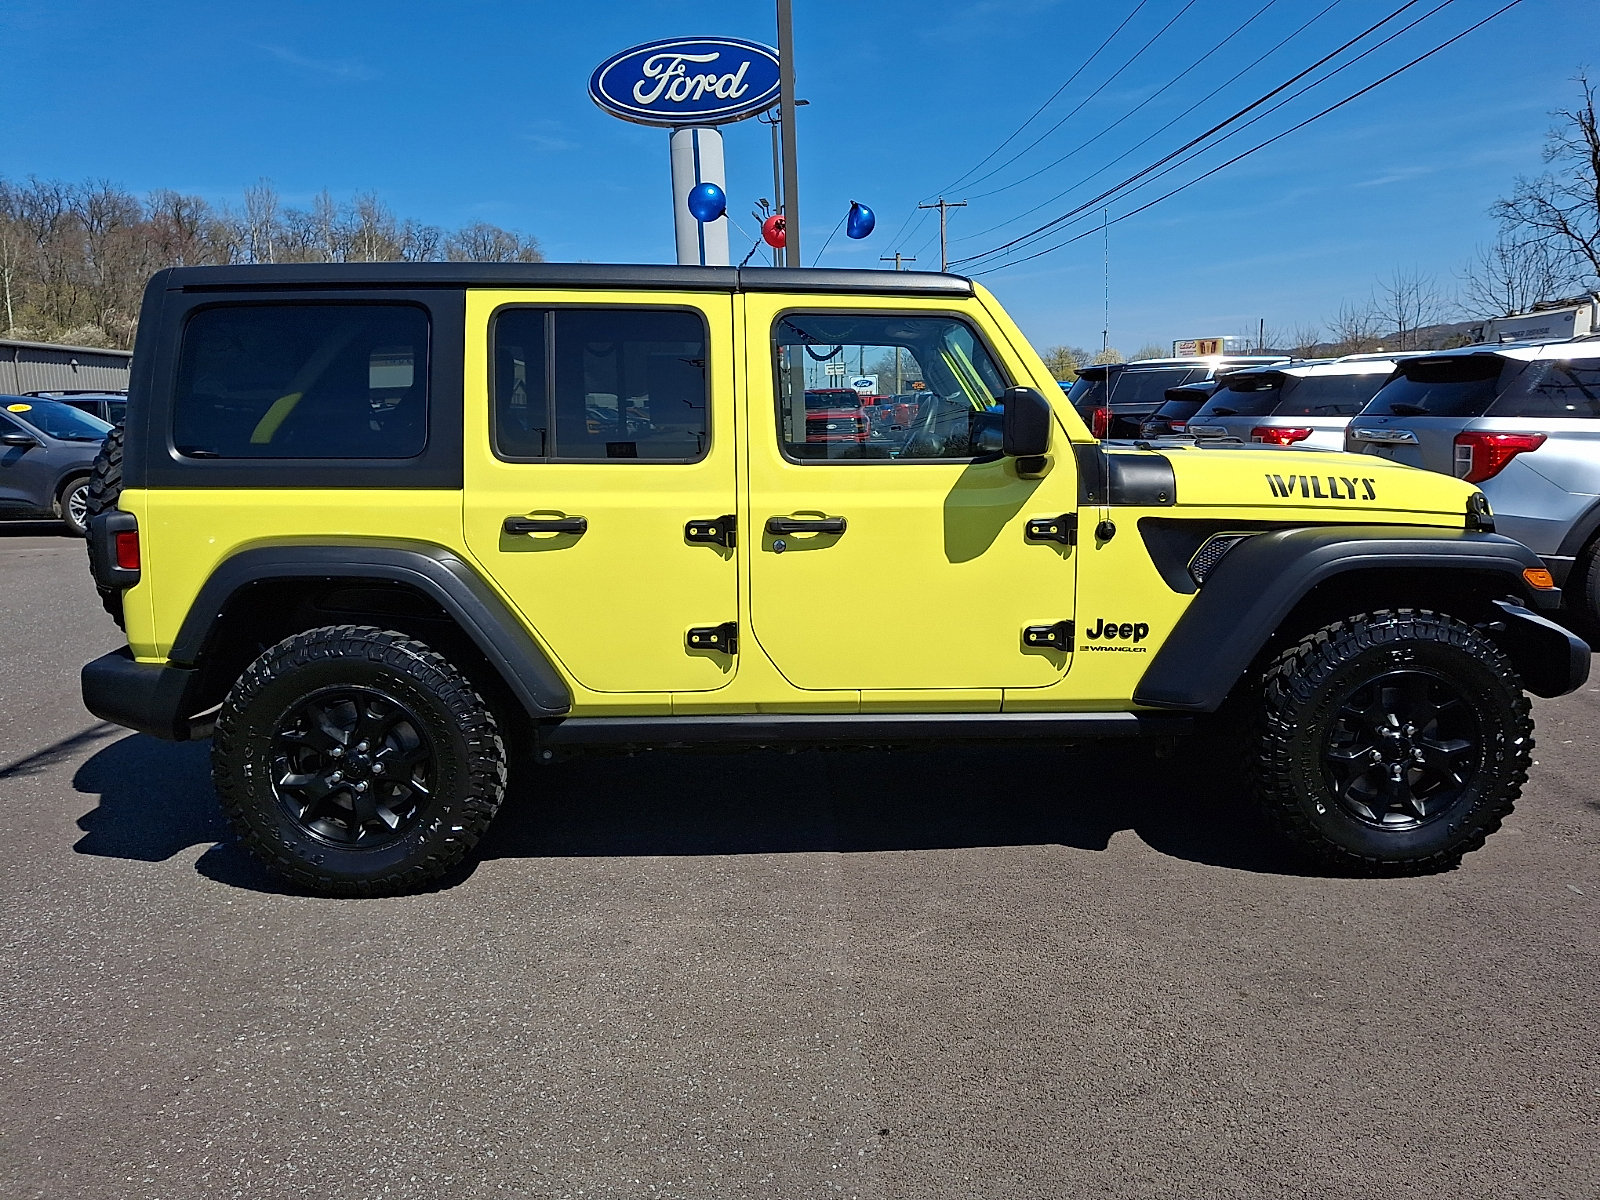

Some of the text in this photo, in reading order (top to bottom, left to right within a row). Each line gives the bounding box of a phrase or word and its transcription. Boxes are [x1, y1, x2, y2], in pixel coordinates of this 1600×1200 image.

[632, 51, 751, 105] Ford
[1265, 474, 1377, 501] WILLYS
[1086, 618, 1149, 643] Jeep
[1090, 645, 1147, 653] WRANGLER
